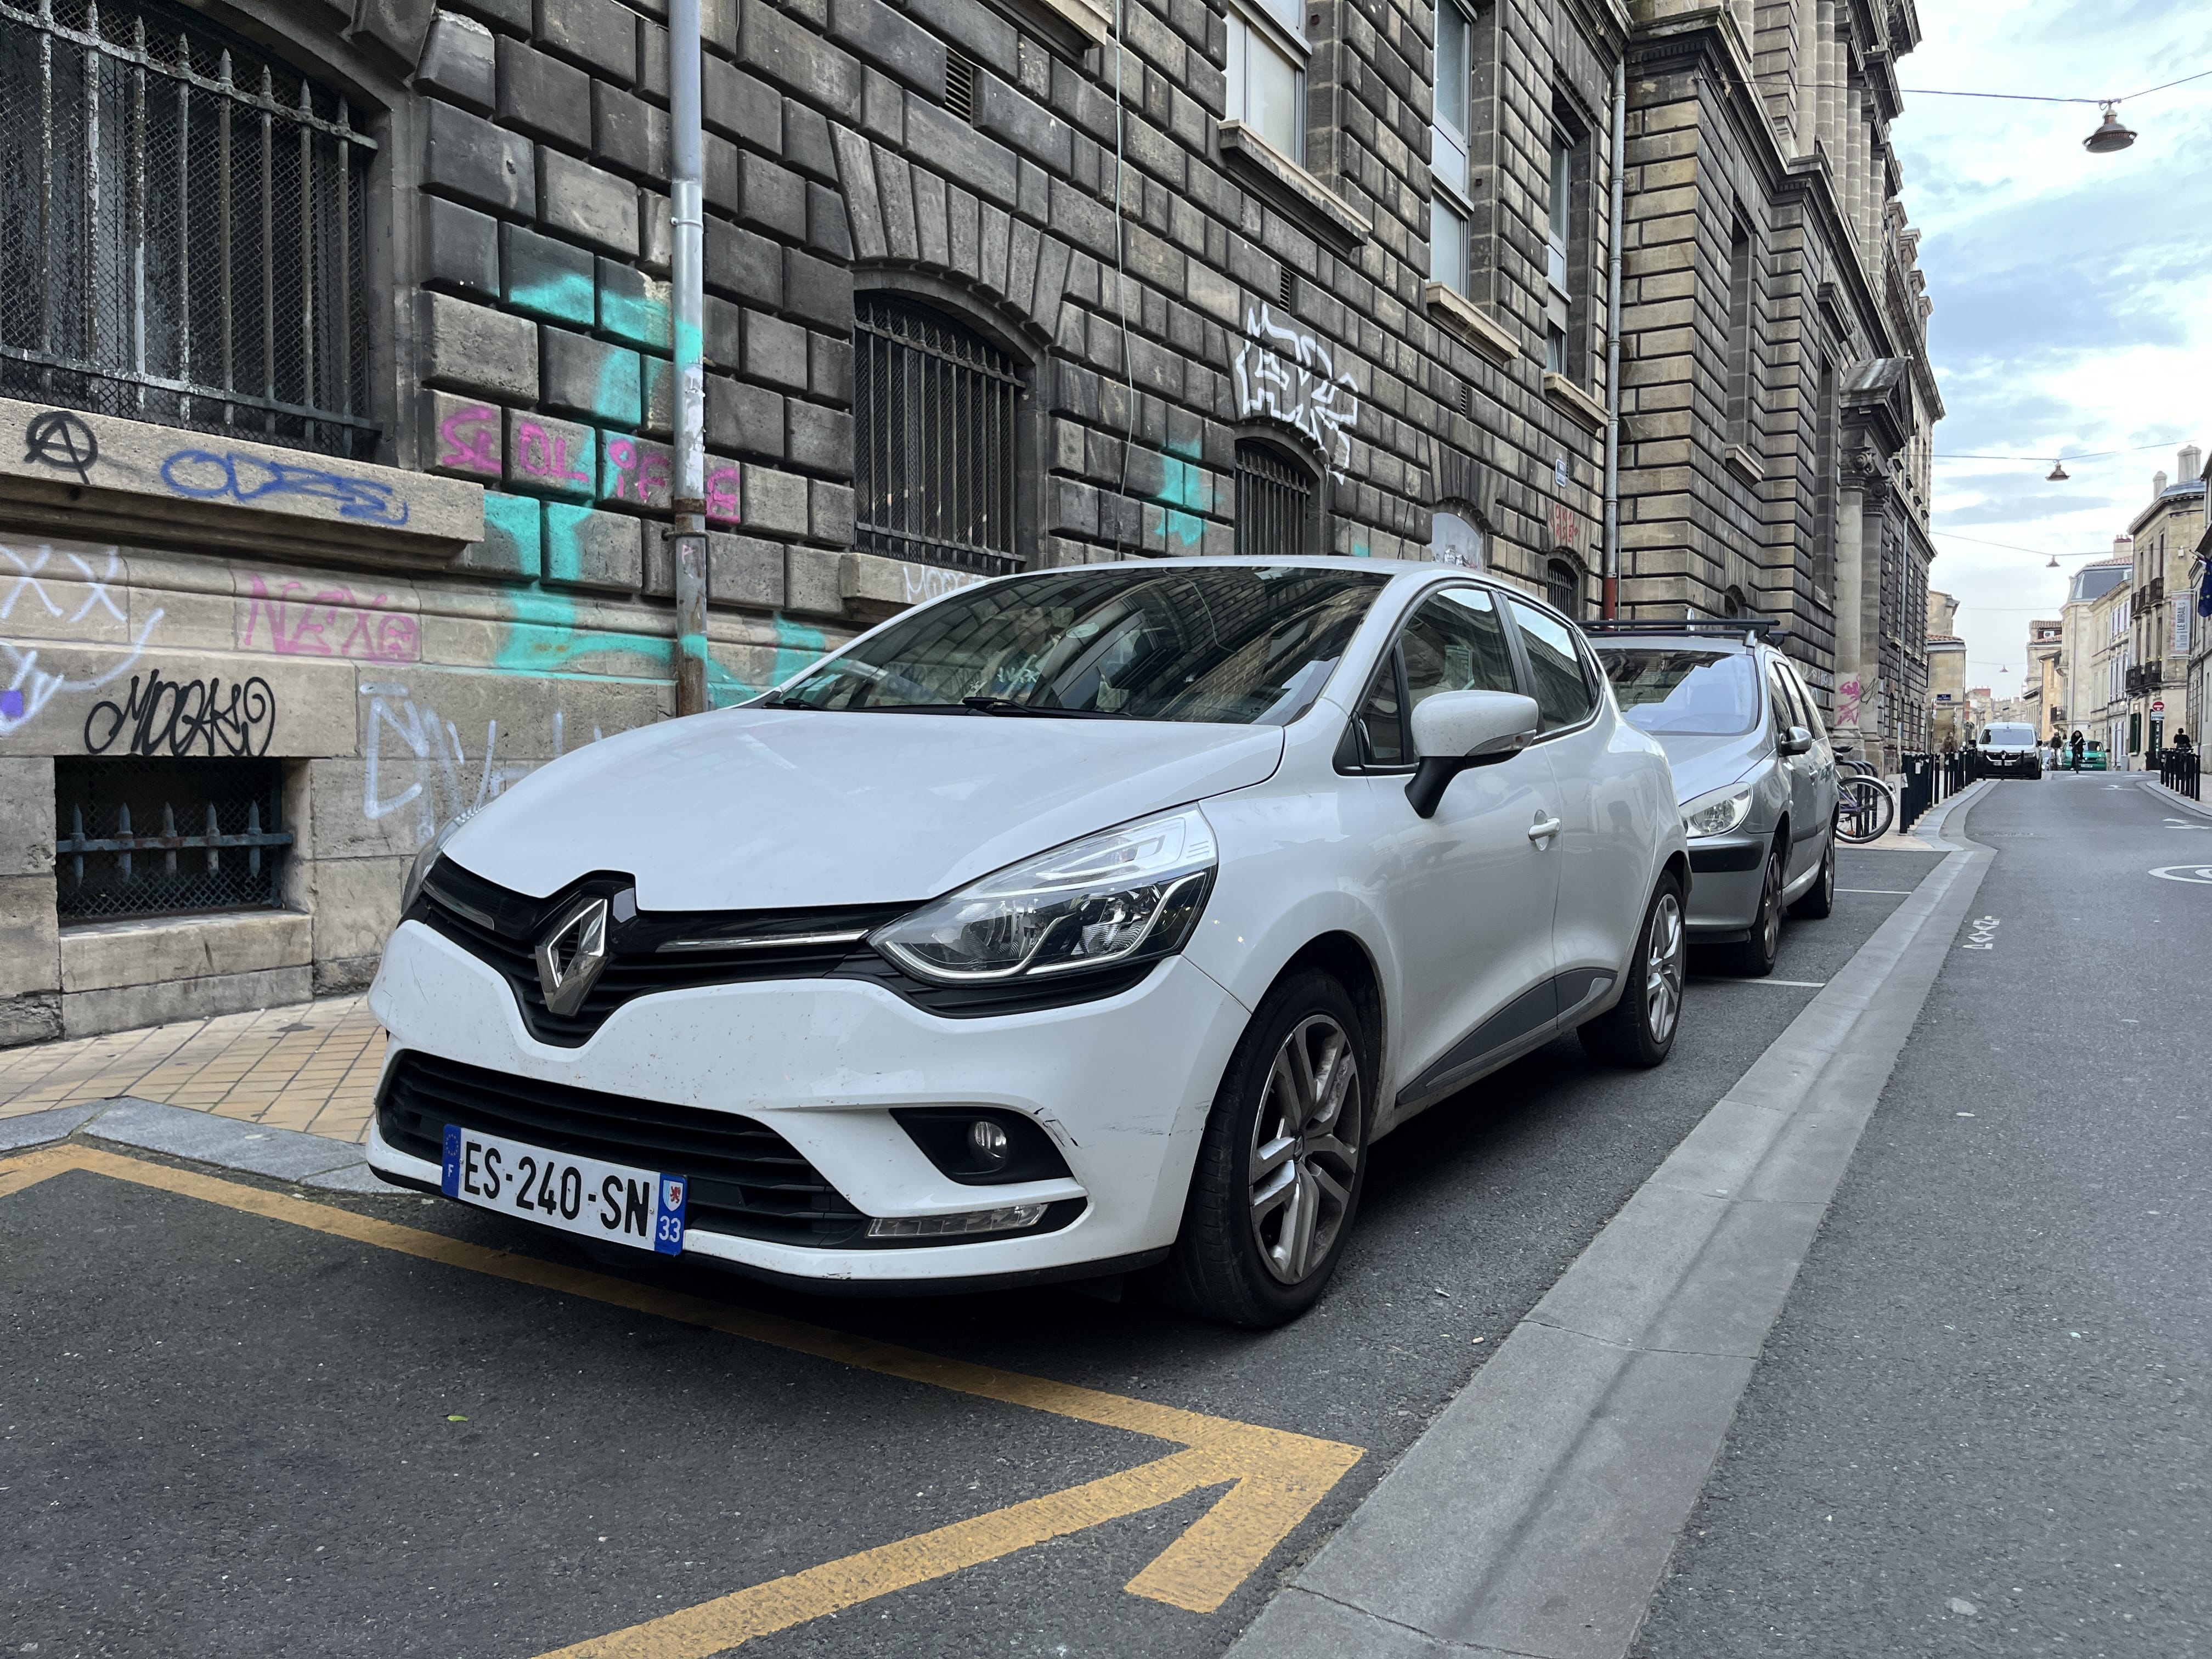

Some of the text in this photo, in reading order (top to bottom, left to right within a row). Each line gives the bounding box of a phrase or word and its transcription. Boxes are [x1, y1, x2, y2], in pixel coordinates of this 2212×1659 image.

[448, 1163, 454, 1177] F
[464, 1141, 651, 1237] ES-240-SN
[658, 1215, 681, 1243] 33
